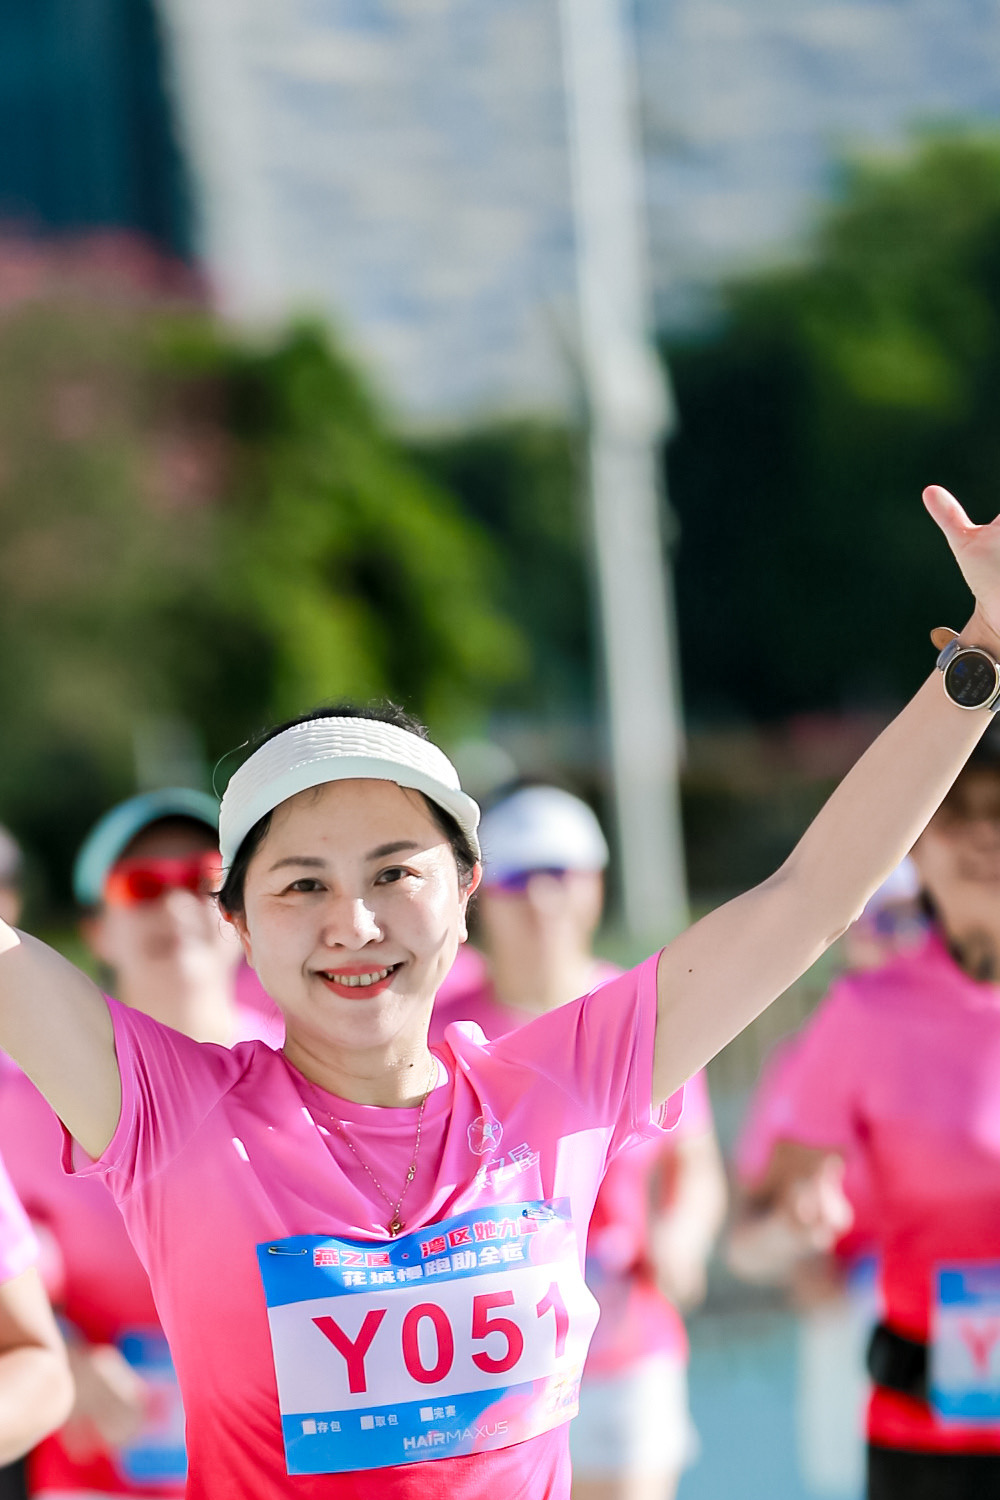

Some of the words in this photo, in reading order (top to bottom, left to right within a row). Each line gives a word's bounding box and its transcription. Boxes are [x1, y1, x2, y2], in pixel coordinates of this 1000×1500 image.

[342, 1242, 525, 1288] 花城慢跑助全运
[312, 1281, 570, 1394] Y051
